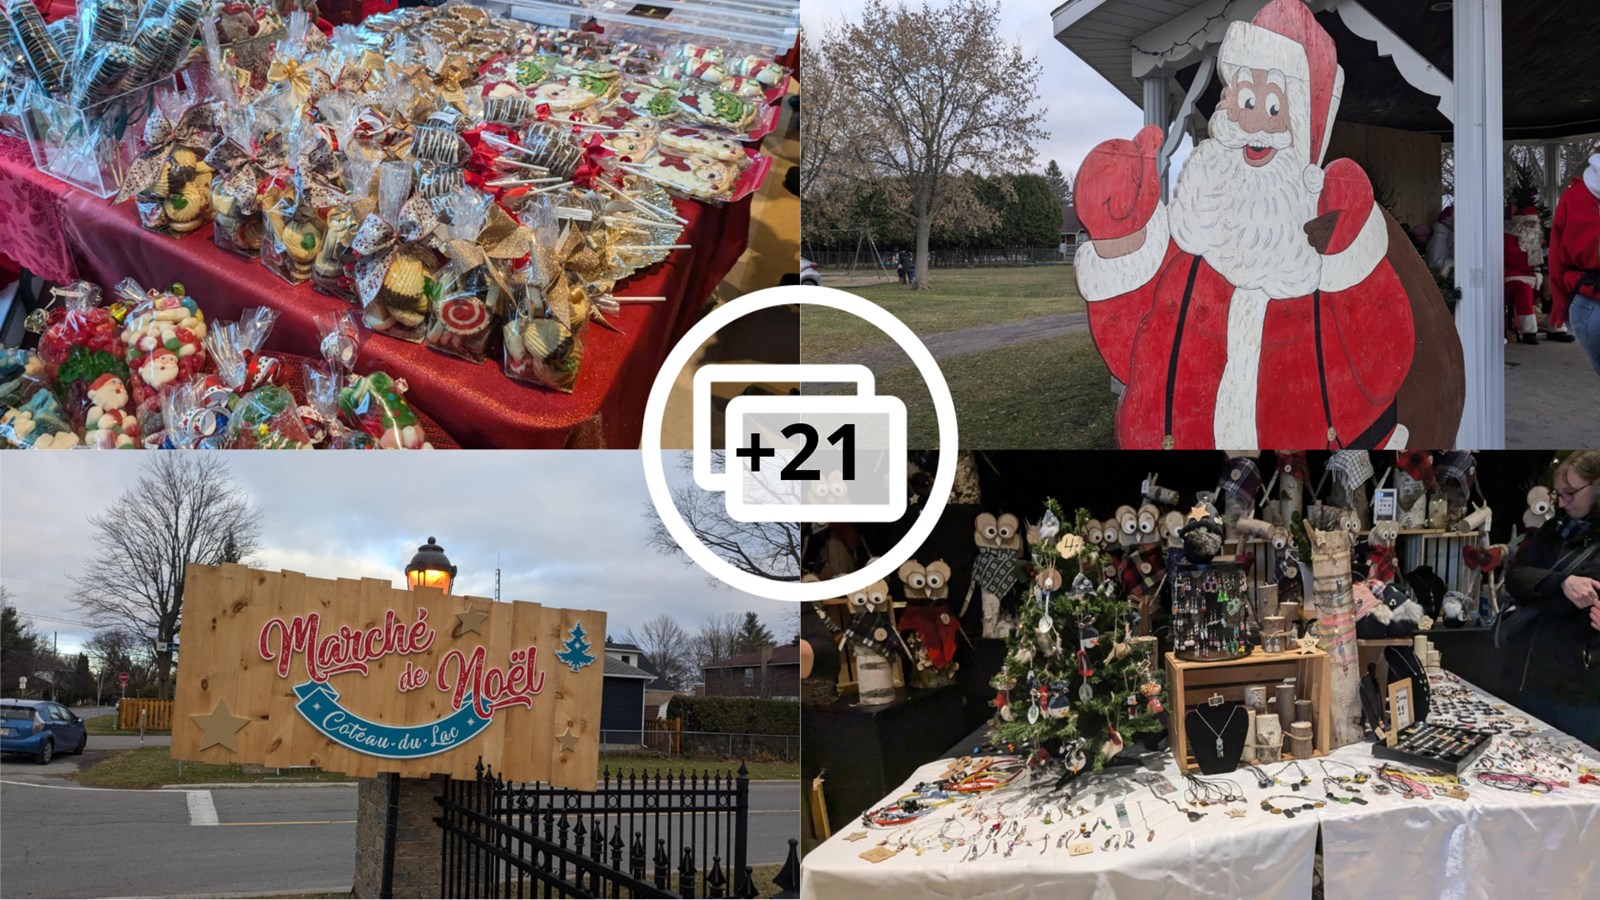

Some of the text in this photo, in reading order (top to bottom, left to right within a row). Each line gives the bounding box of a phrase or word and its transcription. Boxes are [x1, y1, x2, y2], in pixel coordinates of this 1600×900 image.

[259, 608, 435, 683] Marché
[398, 646, 545, 718] de Noël
